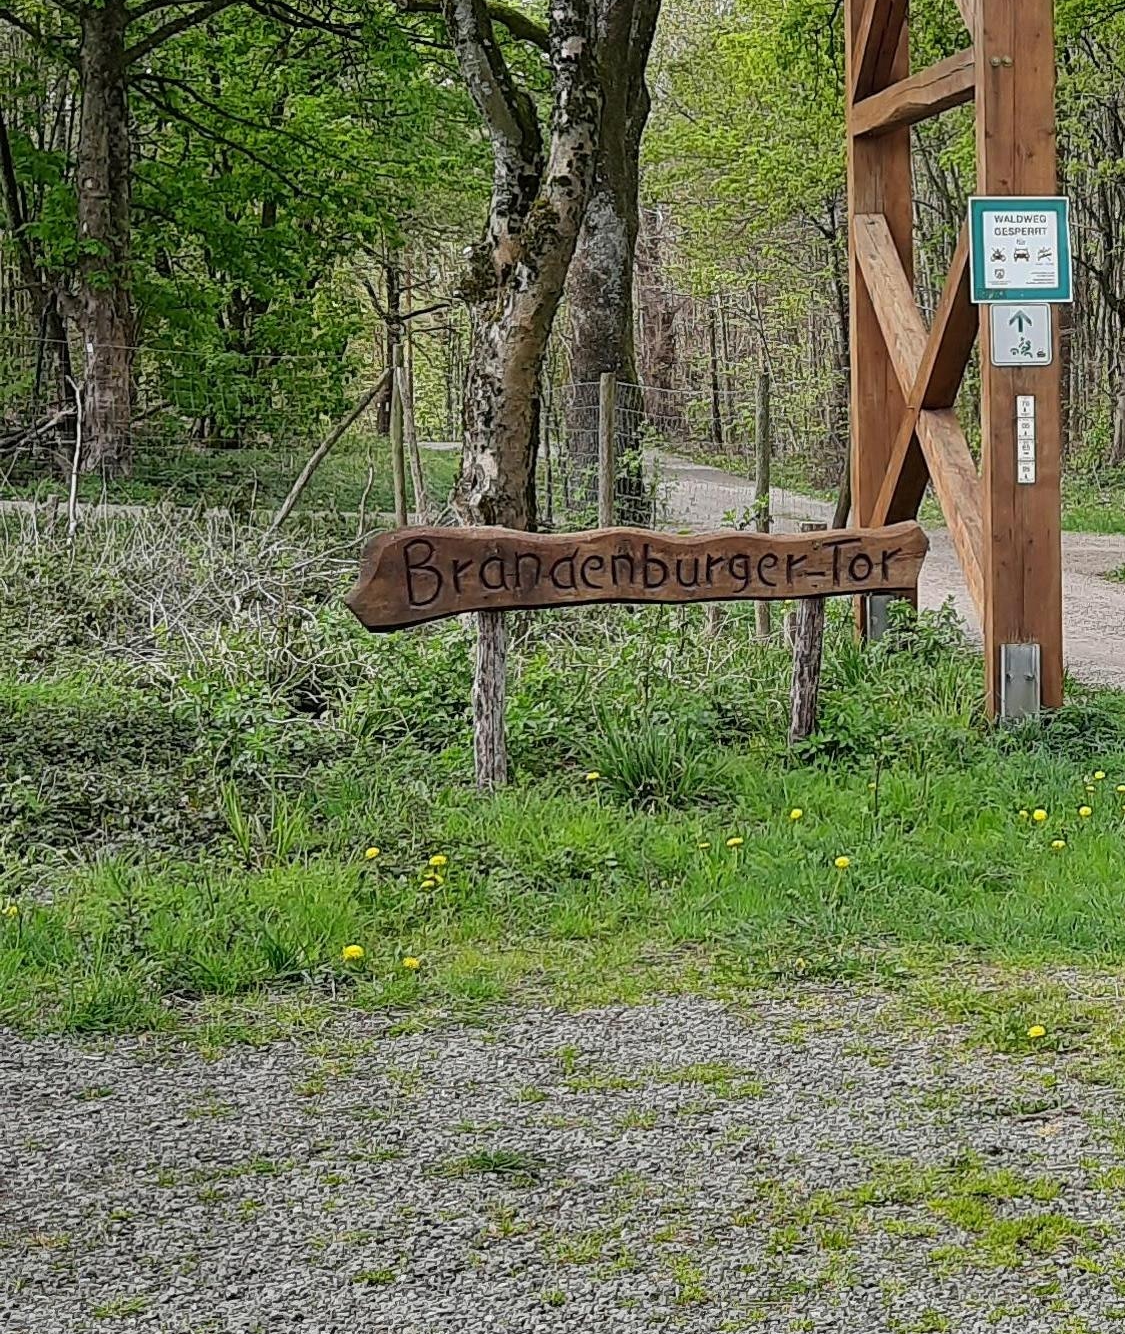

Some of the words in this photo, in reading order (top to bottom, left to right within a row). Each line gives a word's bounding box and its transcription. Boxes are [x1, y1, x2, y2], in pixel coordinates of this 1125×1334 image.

[994, 215, 1047, 224] WALDWEG
[994, 227, 1048, 236] GESPERRT
[402, 537, 901, 607] Brandenburger-Tor
